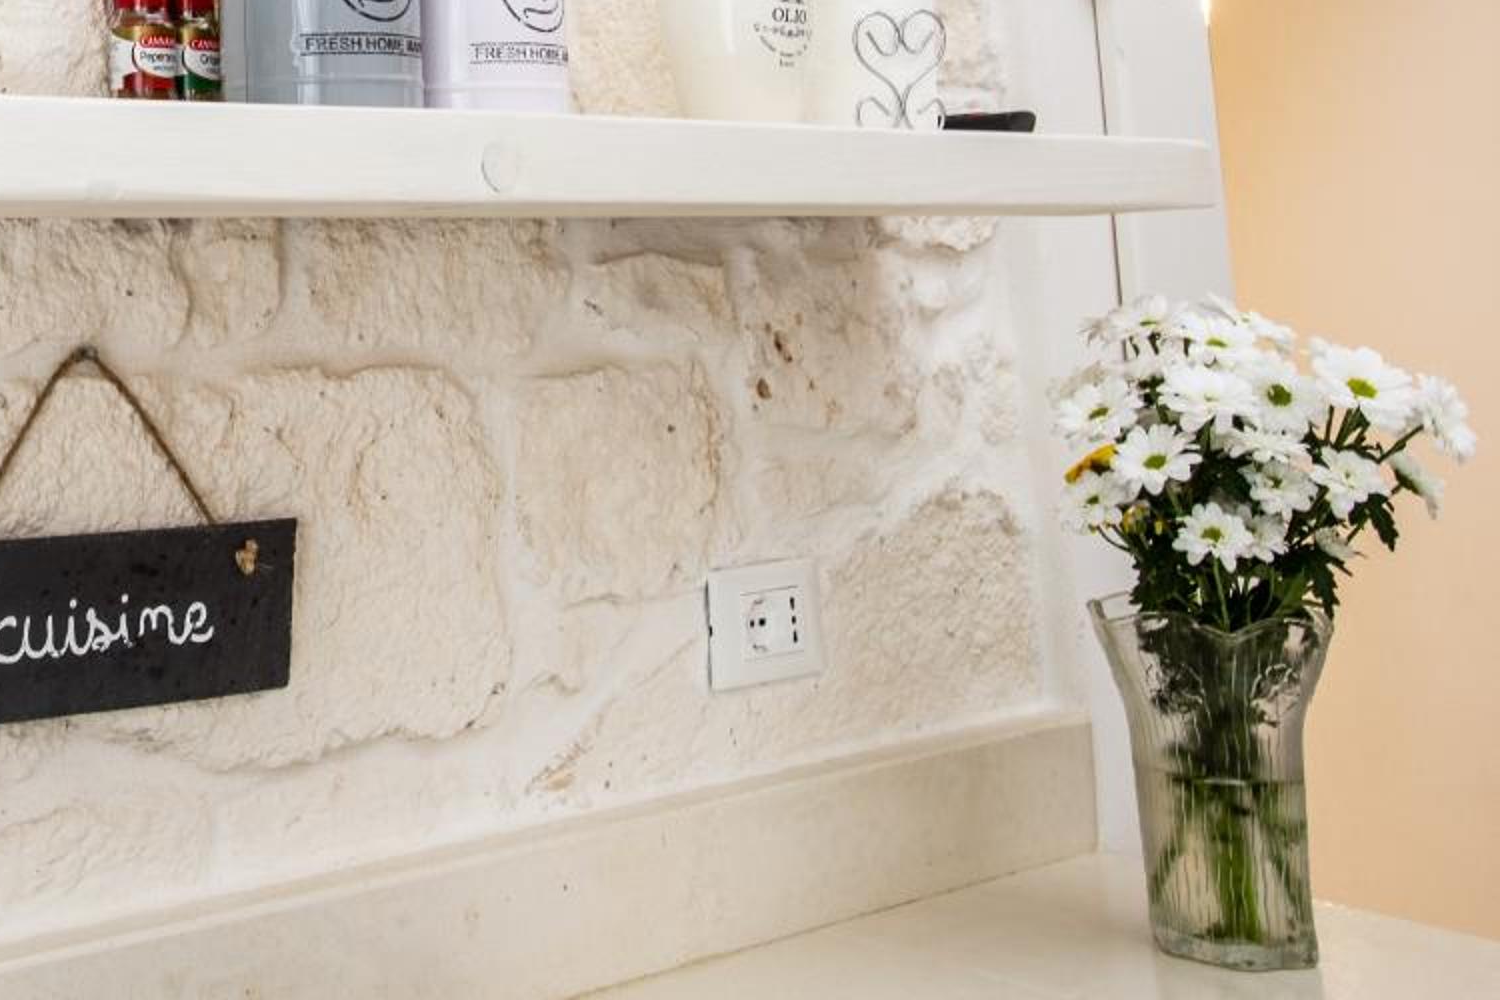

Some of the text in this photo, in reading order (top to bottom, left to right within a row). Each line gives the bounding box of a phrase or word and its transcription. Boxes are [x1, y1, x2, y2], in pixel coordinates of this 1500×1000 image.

[772, 8, 807, 24] OLIO
[304, 37, 362, 51] FRESH
[474, 46, 526, 59] FRESH
